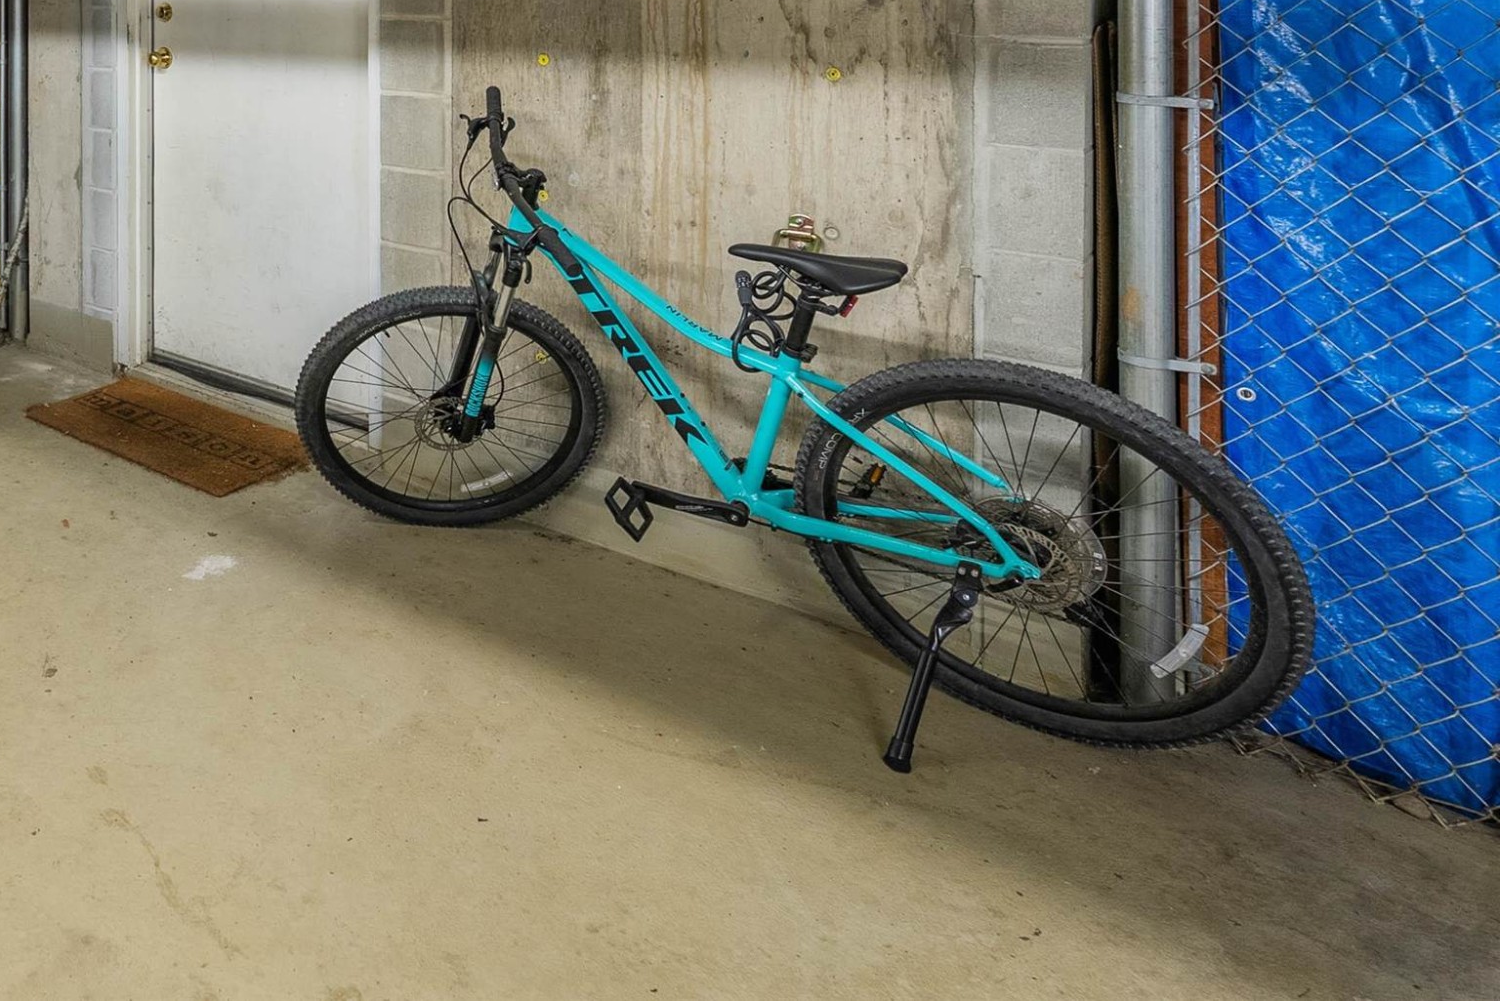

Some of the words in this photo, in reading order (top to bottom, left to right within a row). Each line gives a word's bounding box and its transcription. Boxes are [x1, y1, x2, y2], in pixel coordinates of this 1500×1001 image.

[666, 304, 722, 342] MARLIN
[568, 265, 708, 447] TREK
[464, 373, 492, 419] ROCKSHOX
[818, 432, 842, 469] COMP
